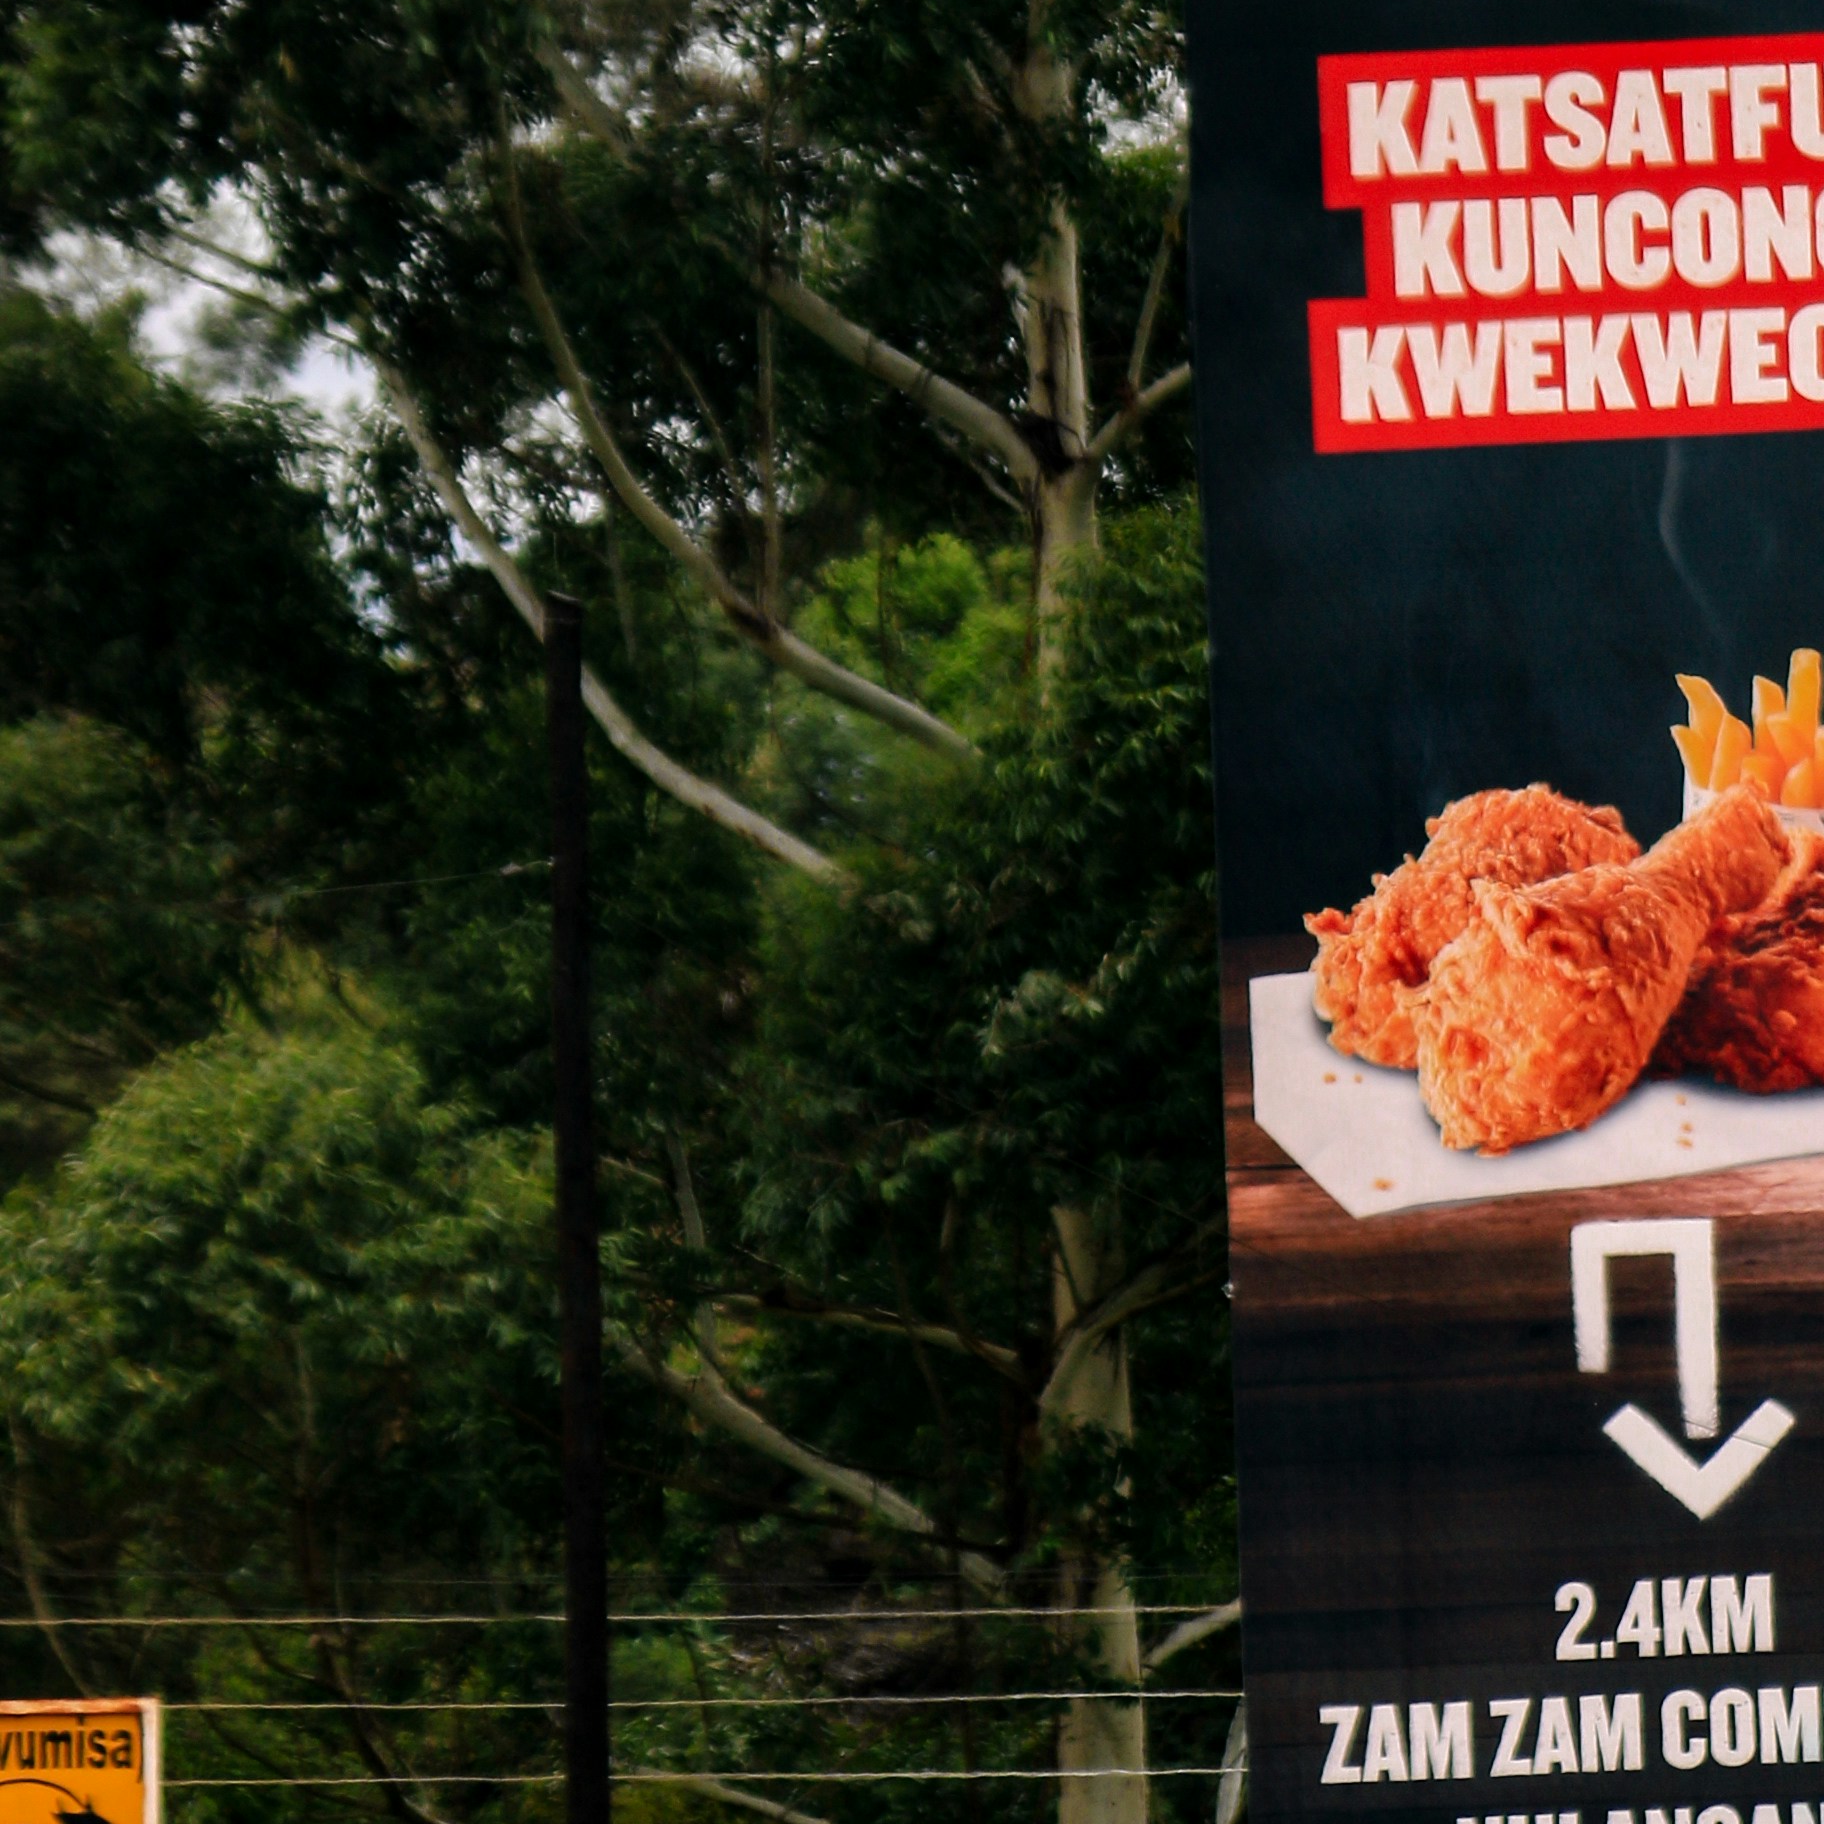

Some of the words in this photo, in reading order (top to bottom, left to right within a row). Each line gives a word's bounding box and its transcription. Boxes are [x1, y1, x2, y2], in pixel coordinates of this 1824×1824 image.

[1554, 1573, 1776, 1660] 2.4KM
[1319, 1699, 1474, 1785] ZAM
[1489, 1692, 1644, 1778] ZAM
